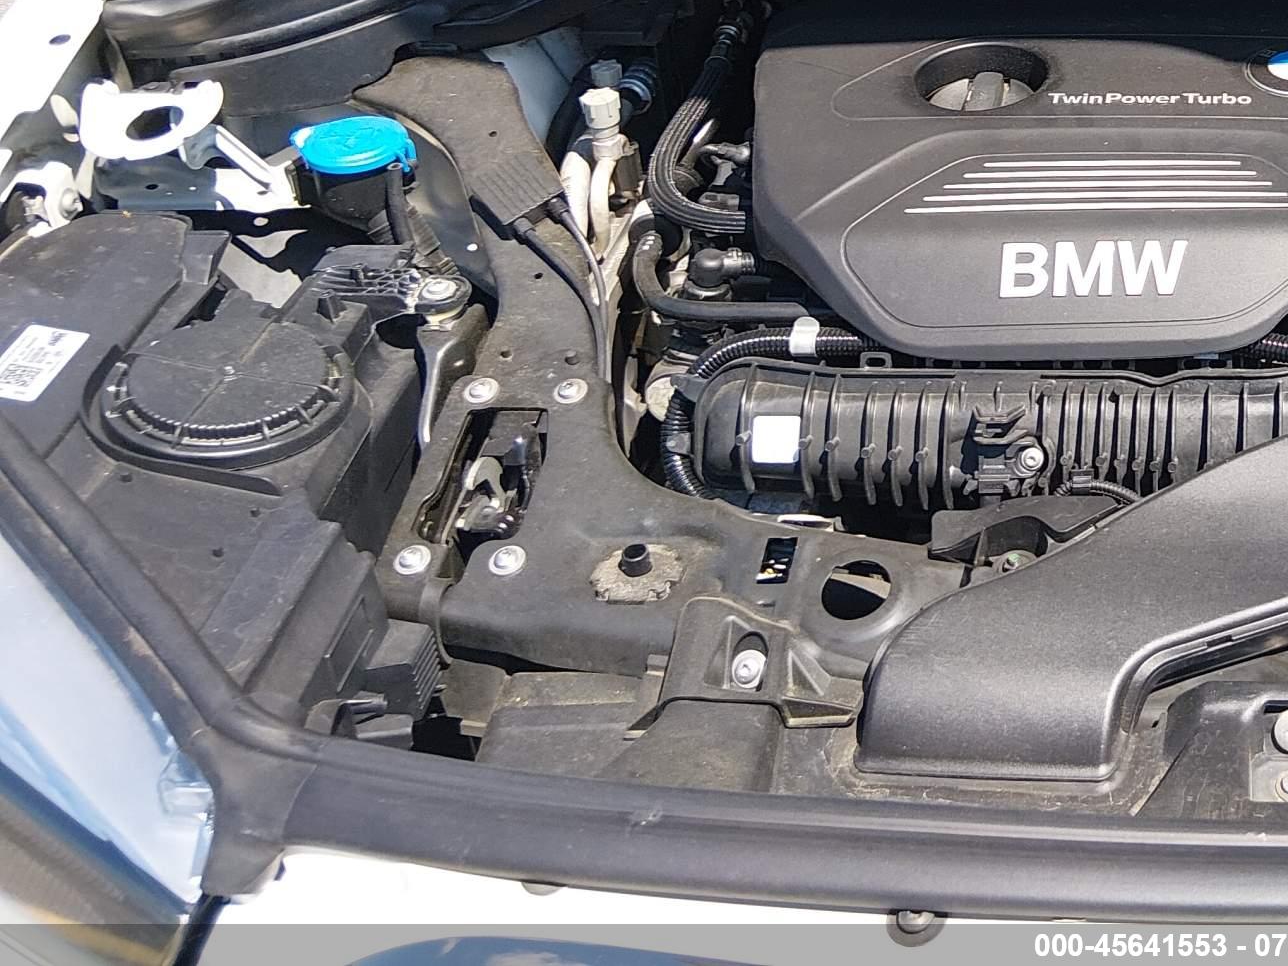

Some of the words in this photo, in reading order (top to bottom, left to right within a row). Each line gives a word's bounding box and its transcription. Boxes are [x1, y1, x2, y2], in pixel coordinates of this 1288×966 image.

[1047, 92, 1181, 105] TwinPower
[1182, 92, 1253, 105] Turbo
[999, 239, 1189, 298] BMW
